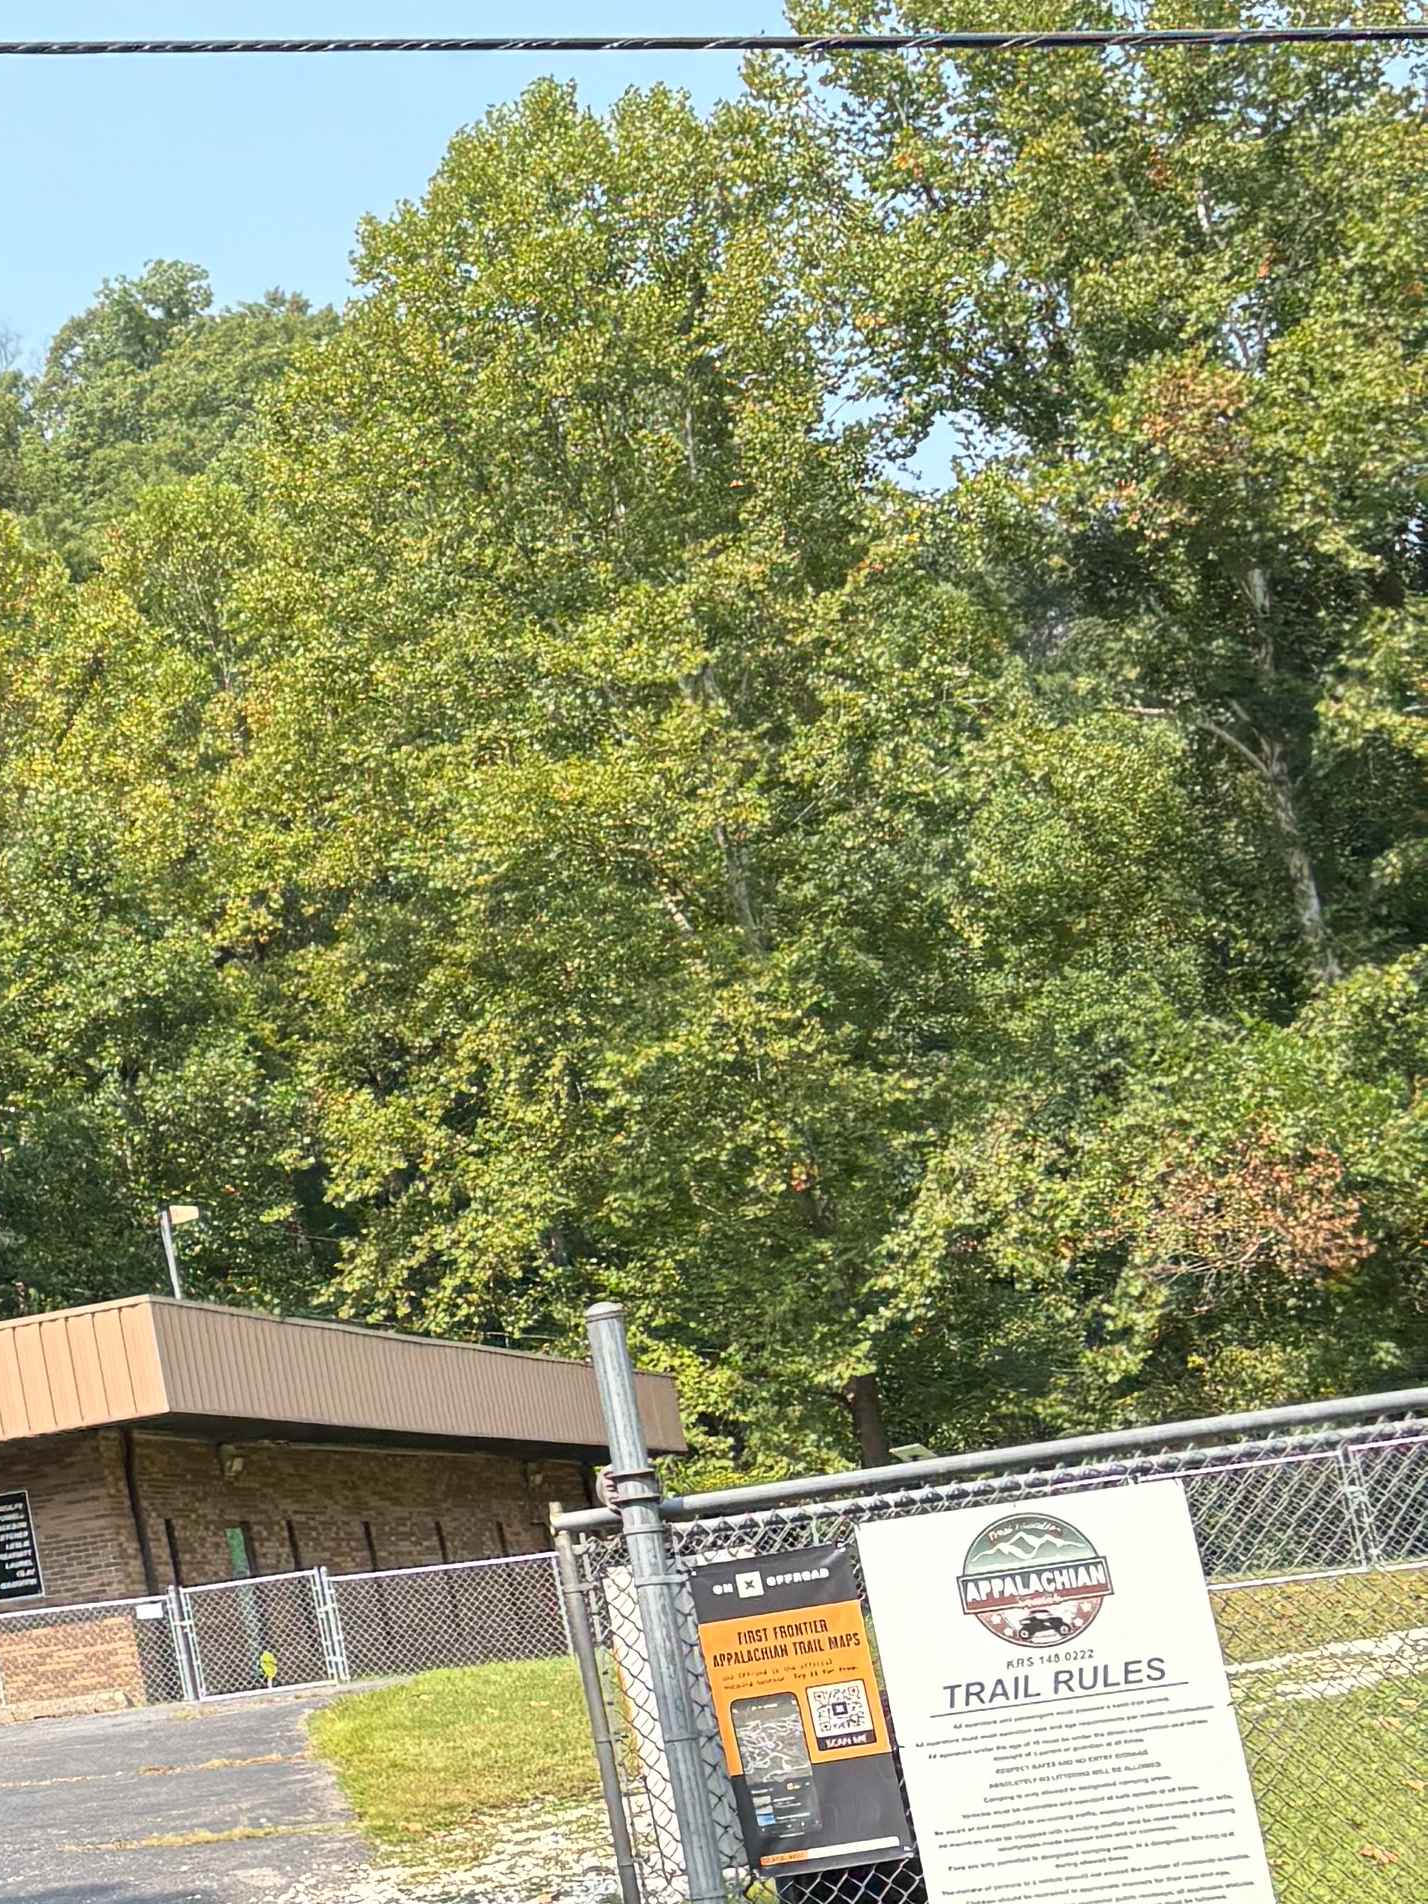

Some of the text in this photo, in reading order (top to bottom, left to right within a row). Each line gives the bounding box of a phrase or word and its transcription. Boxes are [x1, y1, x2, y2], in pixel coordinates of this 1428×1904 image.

[766, 1567, 830, 1587] OFFROAD
[966, 1564, 1105, 1602] APPALACHIAN
[712, 1632, 861, 1668] APPALACHIAN TRAIL MAPS
[737, 1619, 829, 1646] FIRST FRONTIER
[943, 1657, 1166, 1709] TRAIL RULES
